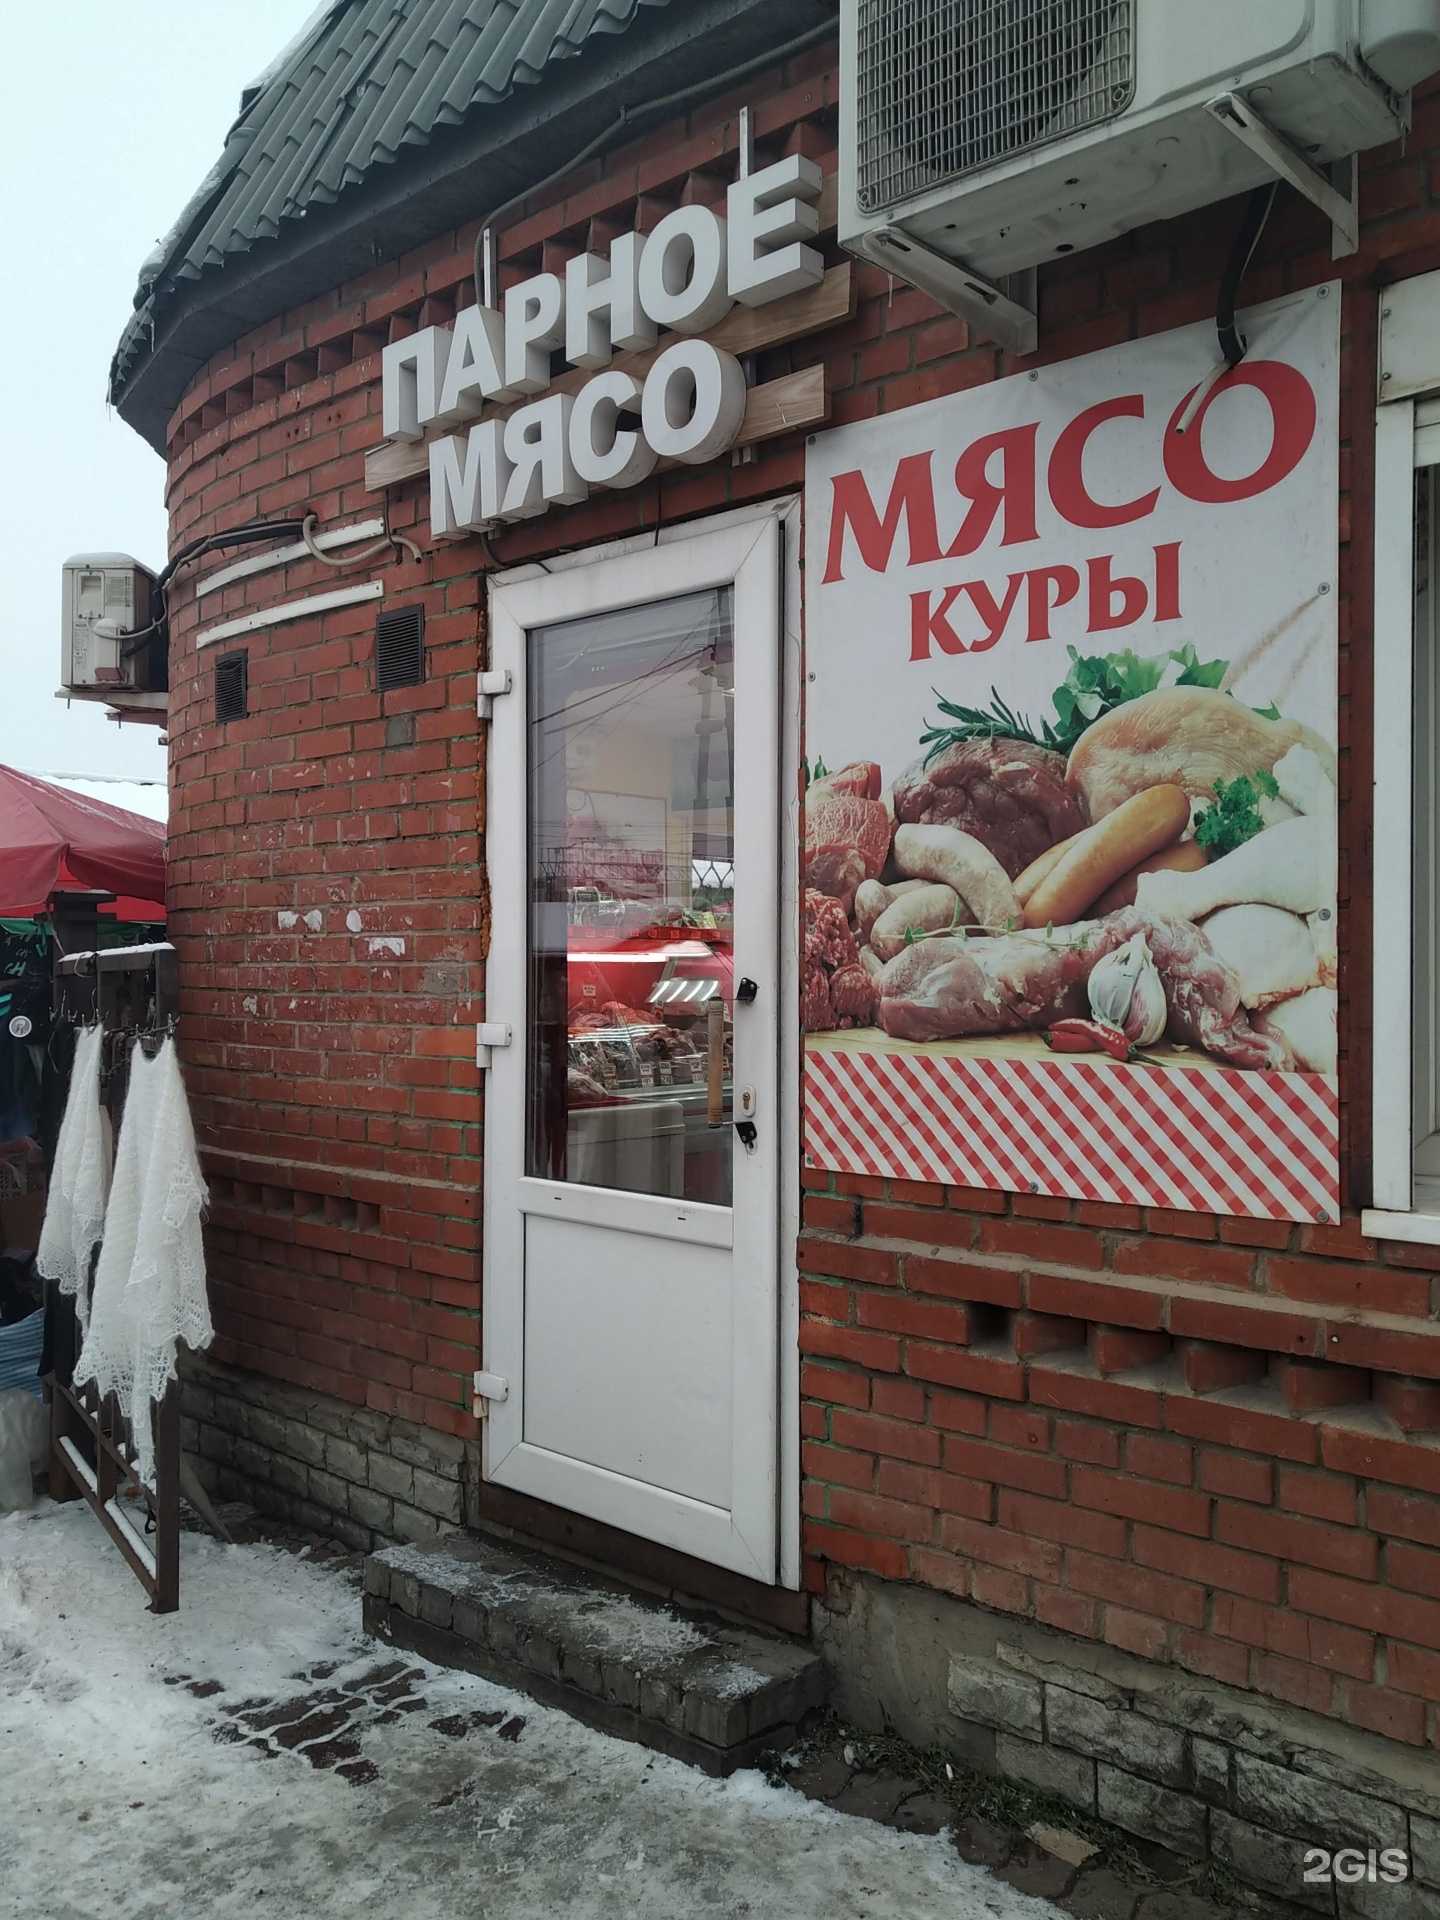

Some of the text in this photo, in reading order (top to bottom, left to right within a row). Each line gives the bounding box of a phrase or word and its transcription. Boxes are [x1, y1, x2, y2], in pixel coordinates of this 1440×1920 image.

[382, 153, 822, 442] ПАРНОЕ
[429, 339, 744, 541] МЯСО
[821, 360, 1317, 585] МЯСО
[908, 540, 1183, 662] КУРЫ
